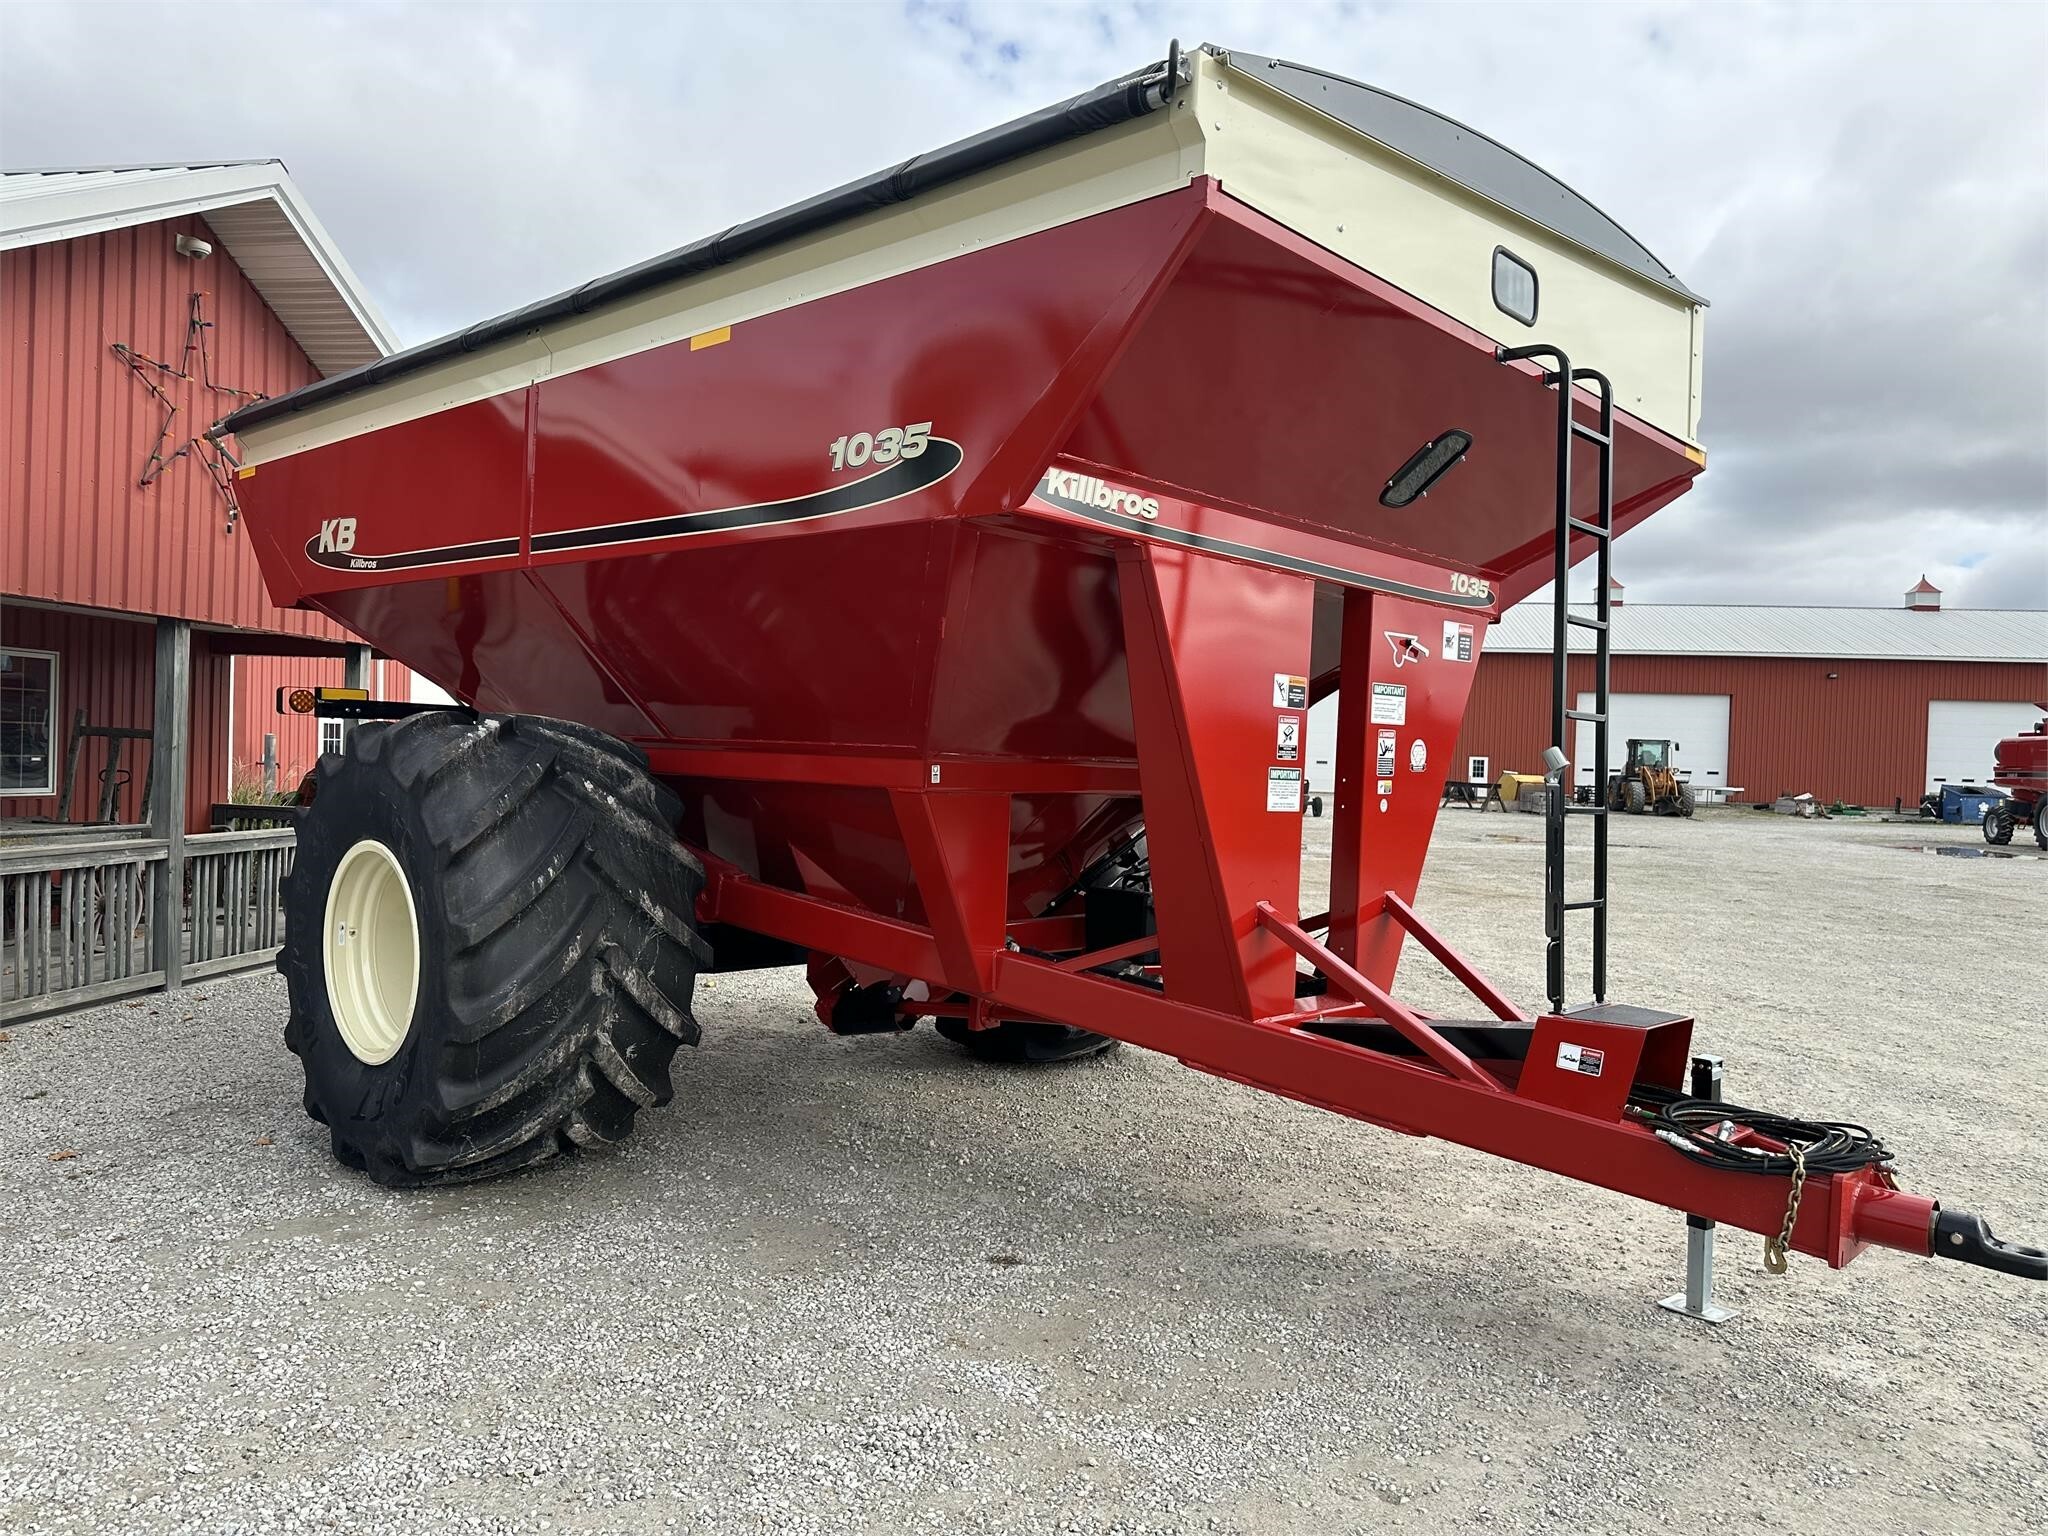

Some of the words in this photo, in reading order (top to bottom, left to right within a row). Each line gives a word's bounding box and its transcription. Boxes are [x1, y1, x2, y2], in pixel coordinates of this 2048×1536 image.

[829, 421, 932, 471] 1035
[1047, 468, 1159, 519] Killbros
[318, 518, 357, 554] KB
[350, 559, 378, 569] Killbros
[1450, 572, 1490, 598] 1035
[1374, 685, 1405, 696] IMPORTANT
[1271, 769, 1300, 780] IMPORTANT
